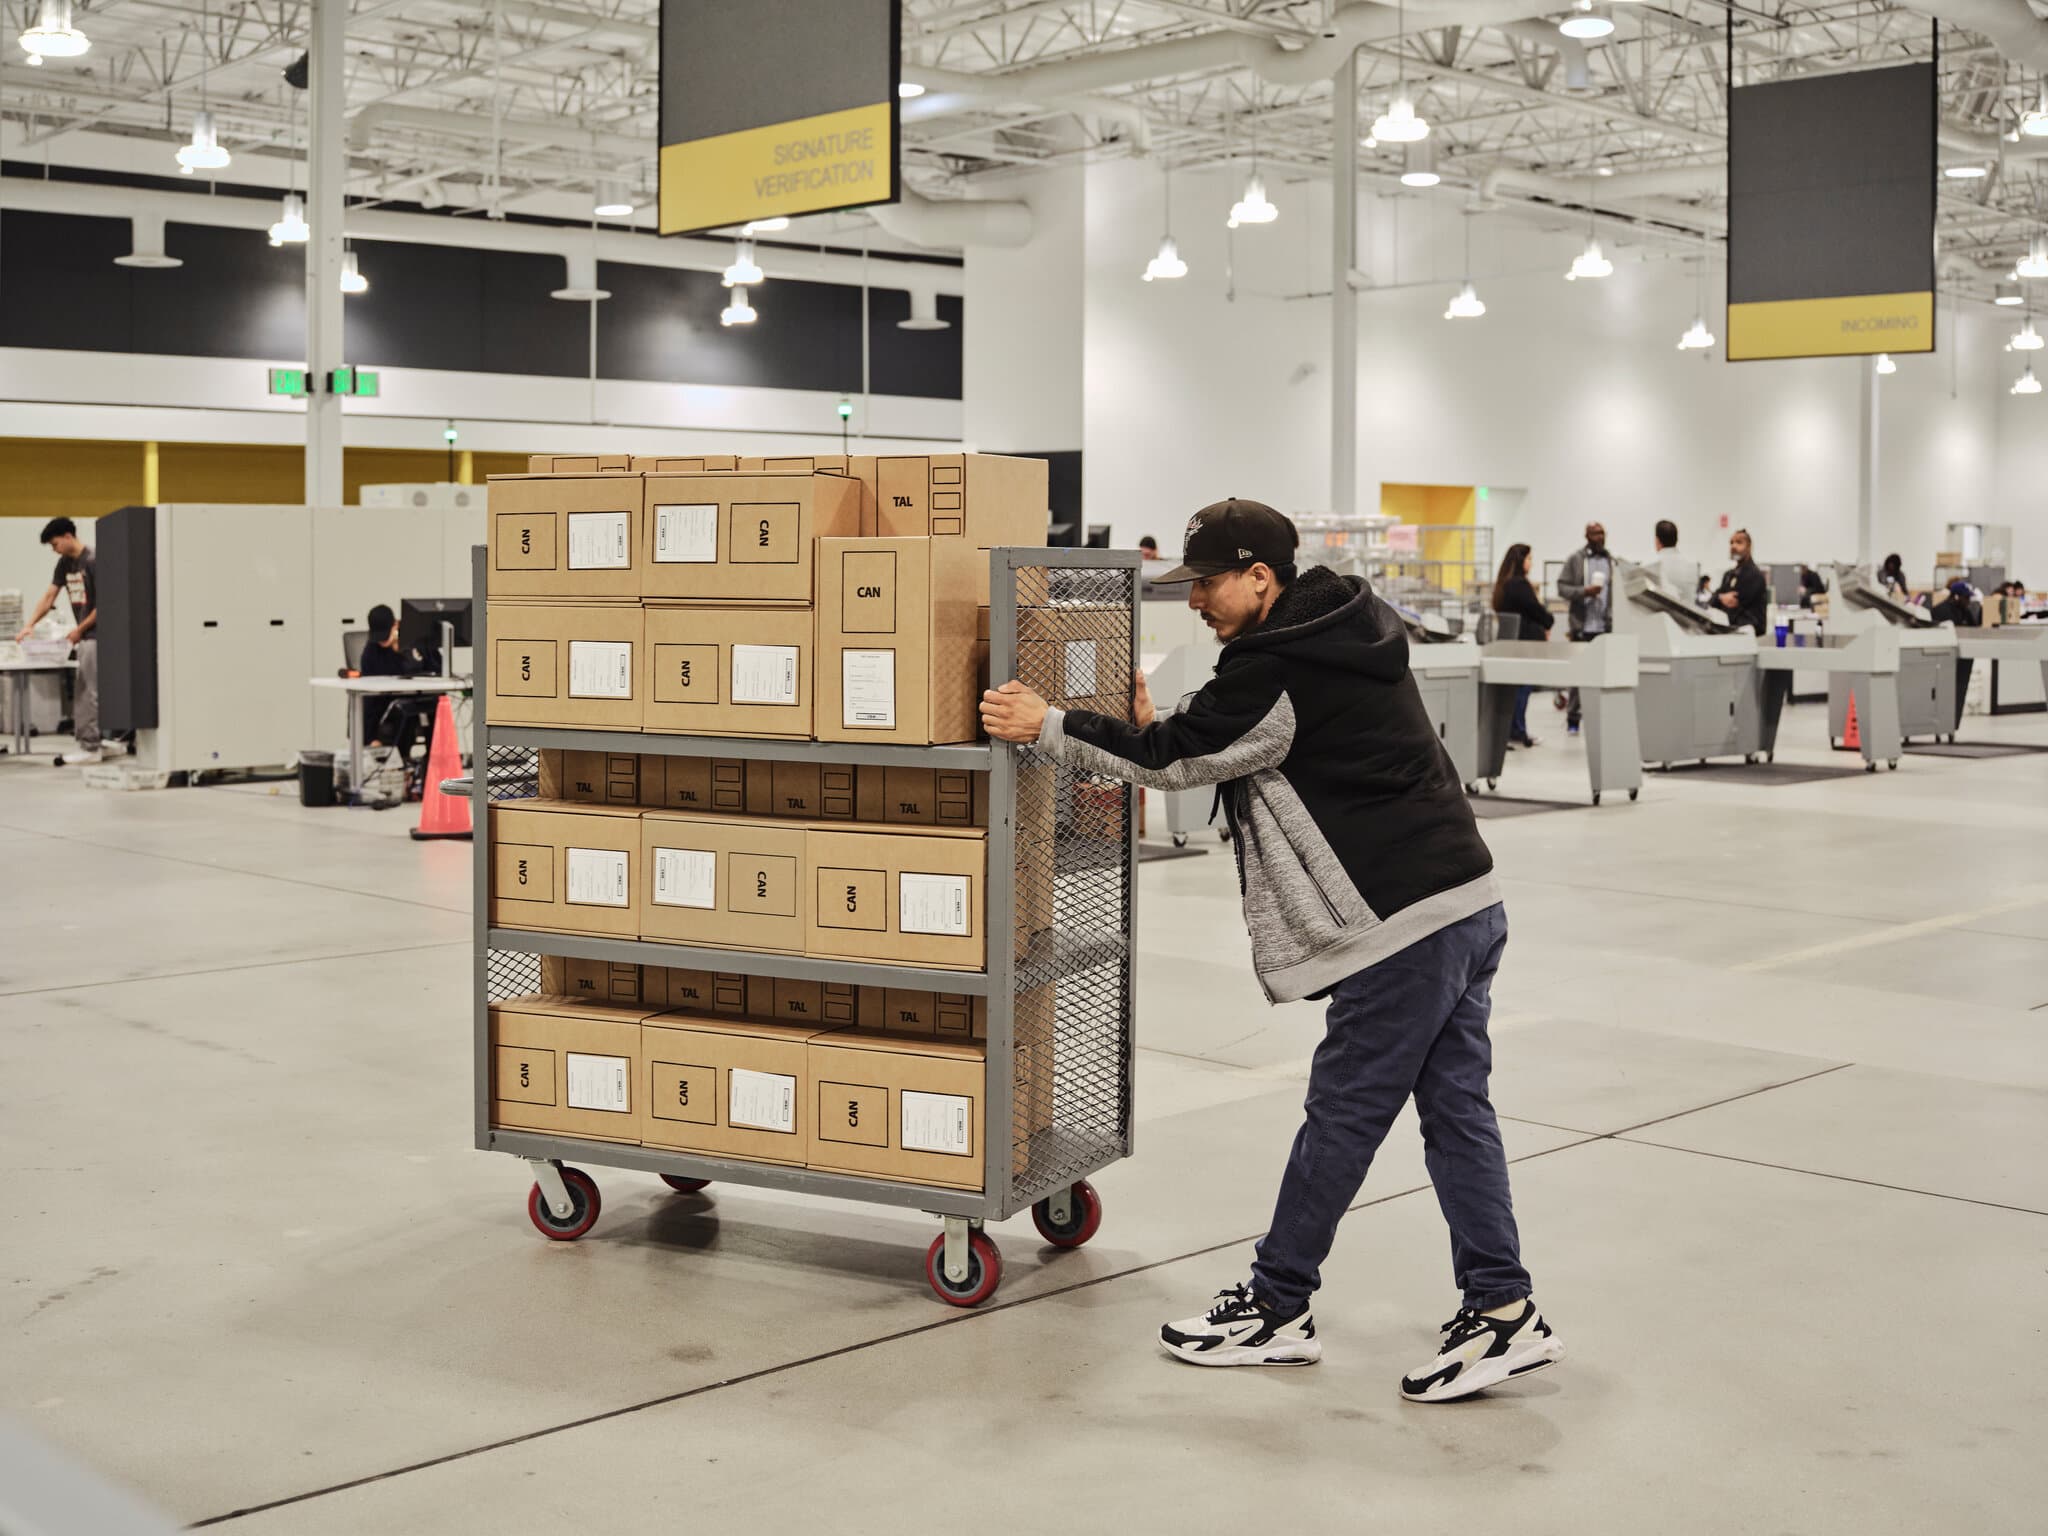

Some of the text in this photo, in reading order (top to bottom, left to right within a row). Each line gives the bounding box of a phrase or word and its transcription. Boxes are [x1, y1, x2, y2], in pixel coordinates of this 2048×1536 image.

[773, 128, 873, 166] SIGNATURE
[754, 159, 874, 198] VERIFICATION
[1840, 314, 1918, 333] INCOMING
[892, 496, 914, 508] TAL
[521, 529, 531, 555] CAN
[759, 519, 770, 547] CAN
[856, 586, 881, 598] CAN
[521, 655, 531, 682] CAN
[681, 660, 691, 687] CAN
[575, 782, 594, 793] TAL
[679, 790, 698, 802] TAL
[786, 797, 807, 809] TAL
[899, 802, 921, 815] TAL
[518, 859, 528, 886] CAN
[757, 871, 767, 898] CAN
[846, 885, 857, 913] CAN
[577, 979, 596, 990] TAL
[680, 987, 700, 1000] TAL
[788, 1000, 808, 1013] TAL
[899, 1010, 921, 1023] TAL
[520, 1063, 530, 1088] CAN
[679, 1080, 689, 1107] CAN
[848, 1100, 859, 1128] CAN
